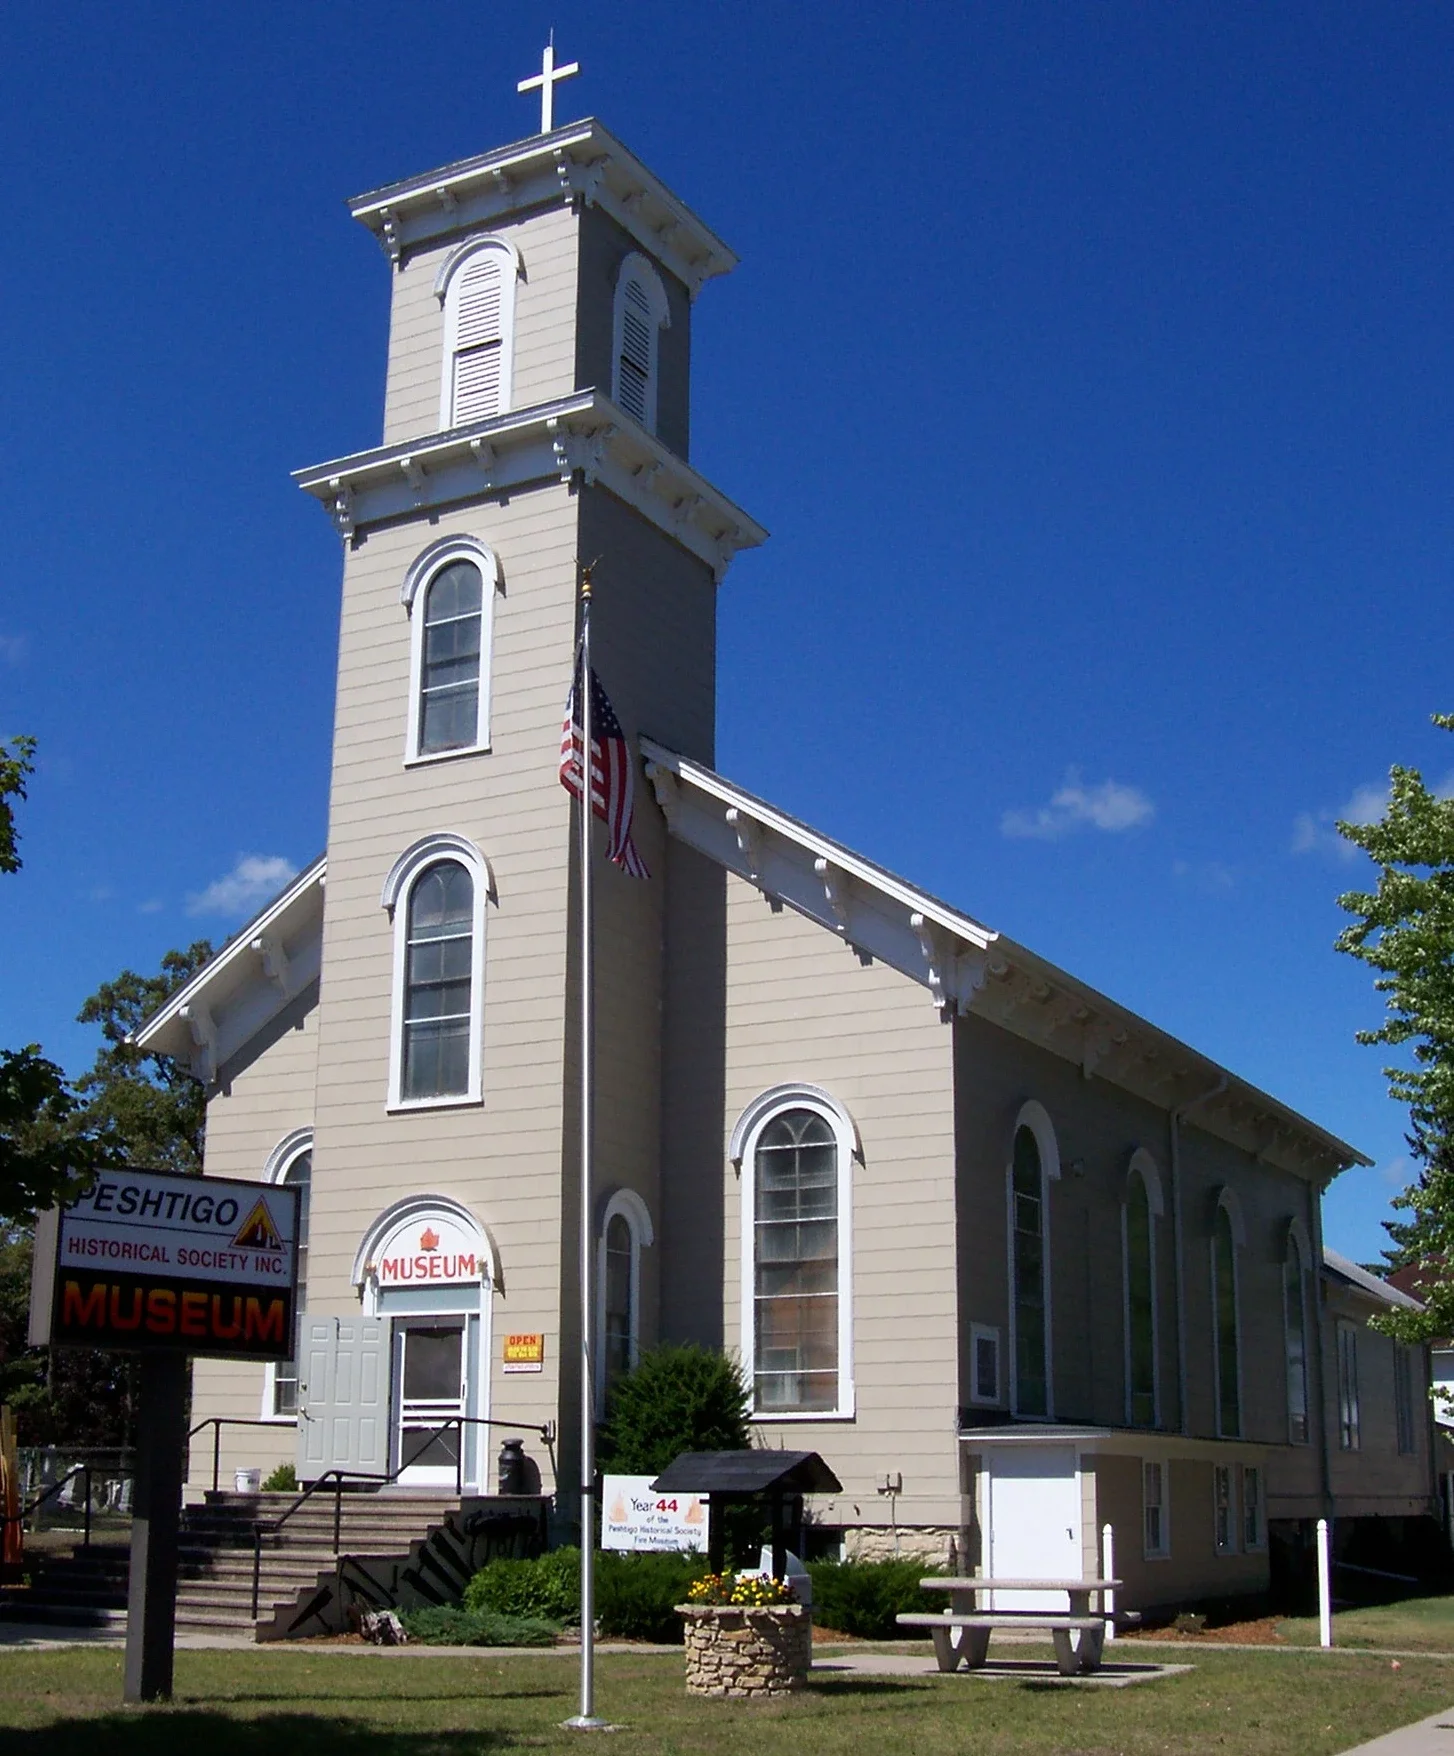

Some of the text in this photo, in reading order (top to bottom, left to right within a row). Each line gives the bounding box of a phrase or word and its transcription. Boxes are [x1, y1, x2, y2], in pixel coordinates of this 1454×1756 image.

[73, 1184, 239, 1226] PESHTIGO
[68, 1237, 287, 1275] HISTORICAL SOCIETY INC.
[382, 1254, 475, 1280] MUSEUM
[62, 1280, 285, 1342] MUSEUM
[509, 1335, 536, 1345] OPEN
[630, 1498, 678, 1512] Year 44
[657, 1515, 669, 1523] the
[674, 1526, 702, 1537] Society
